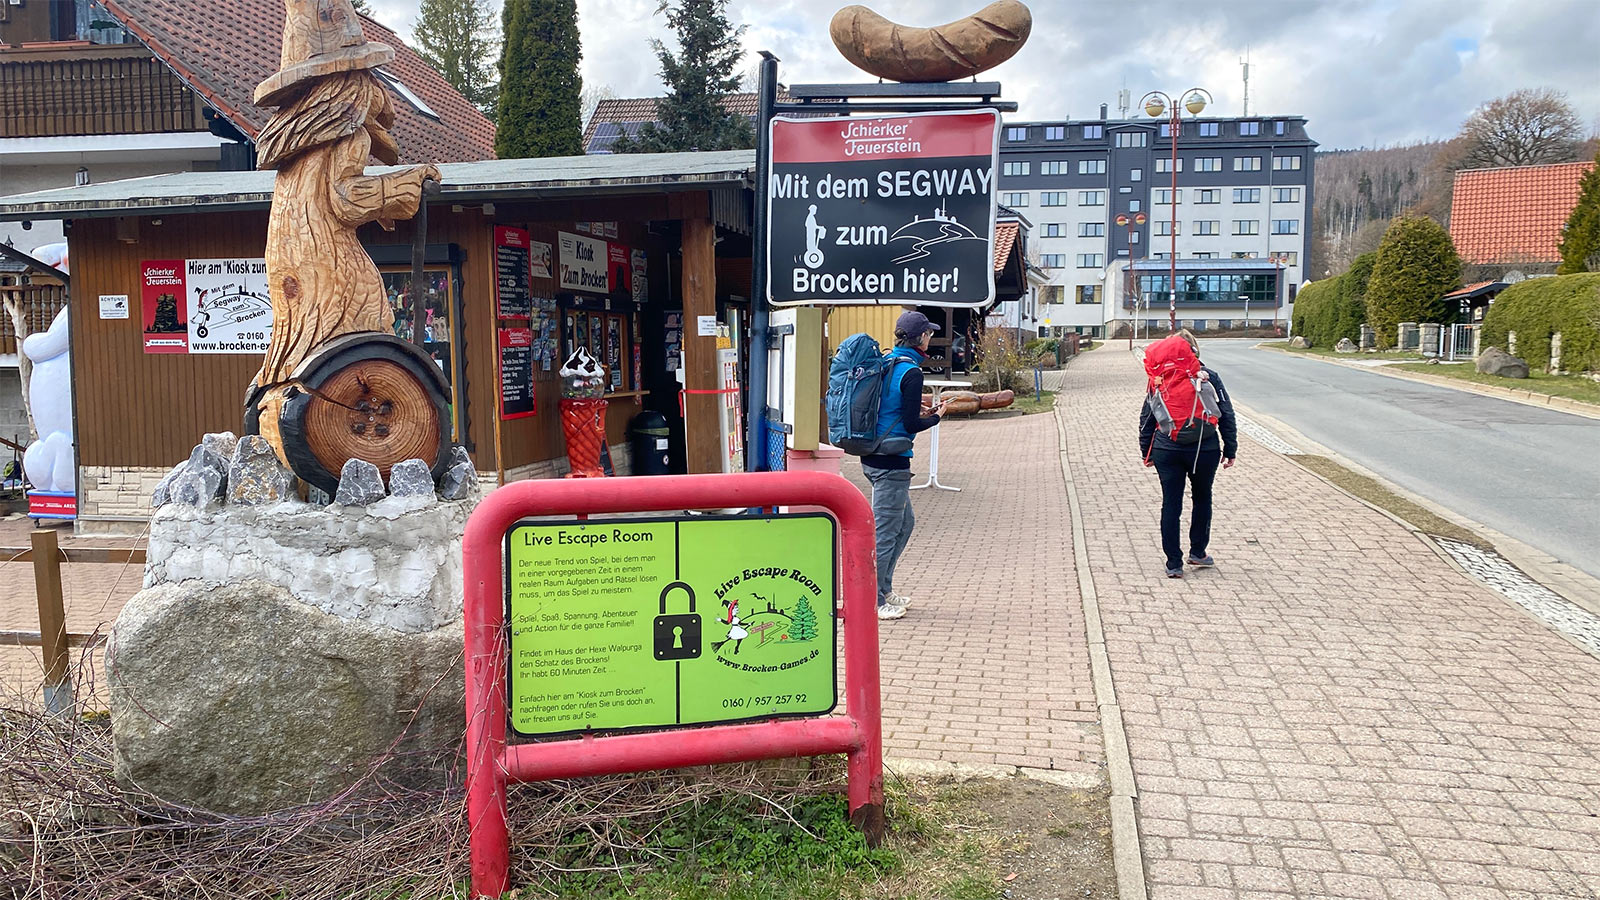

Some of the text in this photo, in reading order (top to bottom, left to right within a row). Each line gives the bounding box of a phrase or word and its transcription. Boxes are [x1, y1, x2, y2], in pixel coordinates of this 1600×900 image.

[841, 122, 909, 139] Schierker
[844, 138, 921, 156] Feuerstein
[772, 168, 993, 199] Mit dem SEGWAY
[835, 225, 888, 246] zum
[576, 240, 594, 262] Kiosk
[144, 267, 176, 277] Schierker
[188, 261, 207, 275] Hier
[208, 263, 222, 275] am
[146, 277, 182, 286] Feuerstein
[222, 283, 235, 291] dem
[793, 267, 959, 293] Brocken hier!
[213, 294, 241, 308] Segway
[232, 303, 245, 312] zum
[236, 309, 266, 323] Brocken
[246, 332, 264, 340] 0160
[192, 340, 270, 351] www.brocken-ex
[524, 529, 653, 548] Live Escape Room
[519, 560, 533, 568] Der
[534, 559, 552, 567] neue
[554, 557, 574, 566] Trend
[576, 558, 589, 566] von
[611, 556, 622, 564] bei
[623, 554, 639, 563] dem
[519, 569, 526, 578] in
[527, 569, 546, 577] einer
[547, 567, 596, 577] vorgegebenen
[598, 566, 612, 574] Zeit
[621, 565, 643, 573] einem
[519, 580, 541, 588] realen
[543, 579, 564, 587] Raum
[566, 577, 599, 587] Aufgaben
[600, 576, 614, 584] und
[713, 566, 822, 600] Live Escape Room
[556, 588, 570, 597] das
[571, 587, 590, 596] Spiel
[590, 587, 599, 595] zu
[602, 609, 638, 618] Abenteuer
[519, 625, 533, 633] und
[534, 624, 558, 632] Action
[559, 622, 569, 631] für
[571, 622, 583, 630] die
[584, 622, 604, 631] ganze
[519, 649, 542, 658] Findet
[555, 647, 573, 656] Haus
[575, 647, 587, 655] der
[589, 645, 607, 654] Hexe
[608, 643, 642, 653] Walpurga
[520, 655, 610, 669] den Schatz des Brockens!
[716, 649, 820, 673] www.Brocken-Games.de
[520, 670, 530, 679] Ihr
[532, 669, 548, 678] habt
[549, 668, 561, 677] 60
[562, 667, 591, 676] Minuten
[593, 665, 607, 674] Zeit
[519, 693, 546, 703] Einfach
[547, 692, 561, 701] hier
[563, 691, 575, 699] am
[599, 689, 614, 698] zum
[722, 697, 744, 709] 0160
[754, 696, 772, 706] 957
[775, 694, 793, 705] 257
[795, 693, 807, 704] 92
[520, 703, 559, 713] nachfragen
[561, 702, 577, 711] oder
[579, 700, 598, 709] rufen
[599, 699, 610, 708] Sie
[626, 698, 643, 706] doch
[520, 716, 531, 724] wir
[533, 714, 556, 723] freuen
[557, 713, 571, 721] uns
[572, 712, 584, 720] auf
